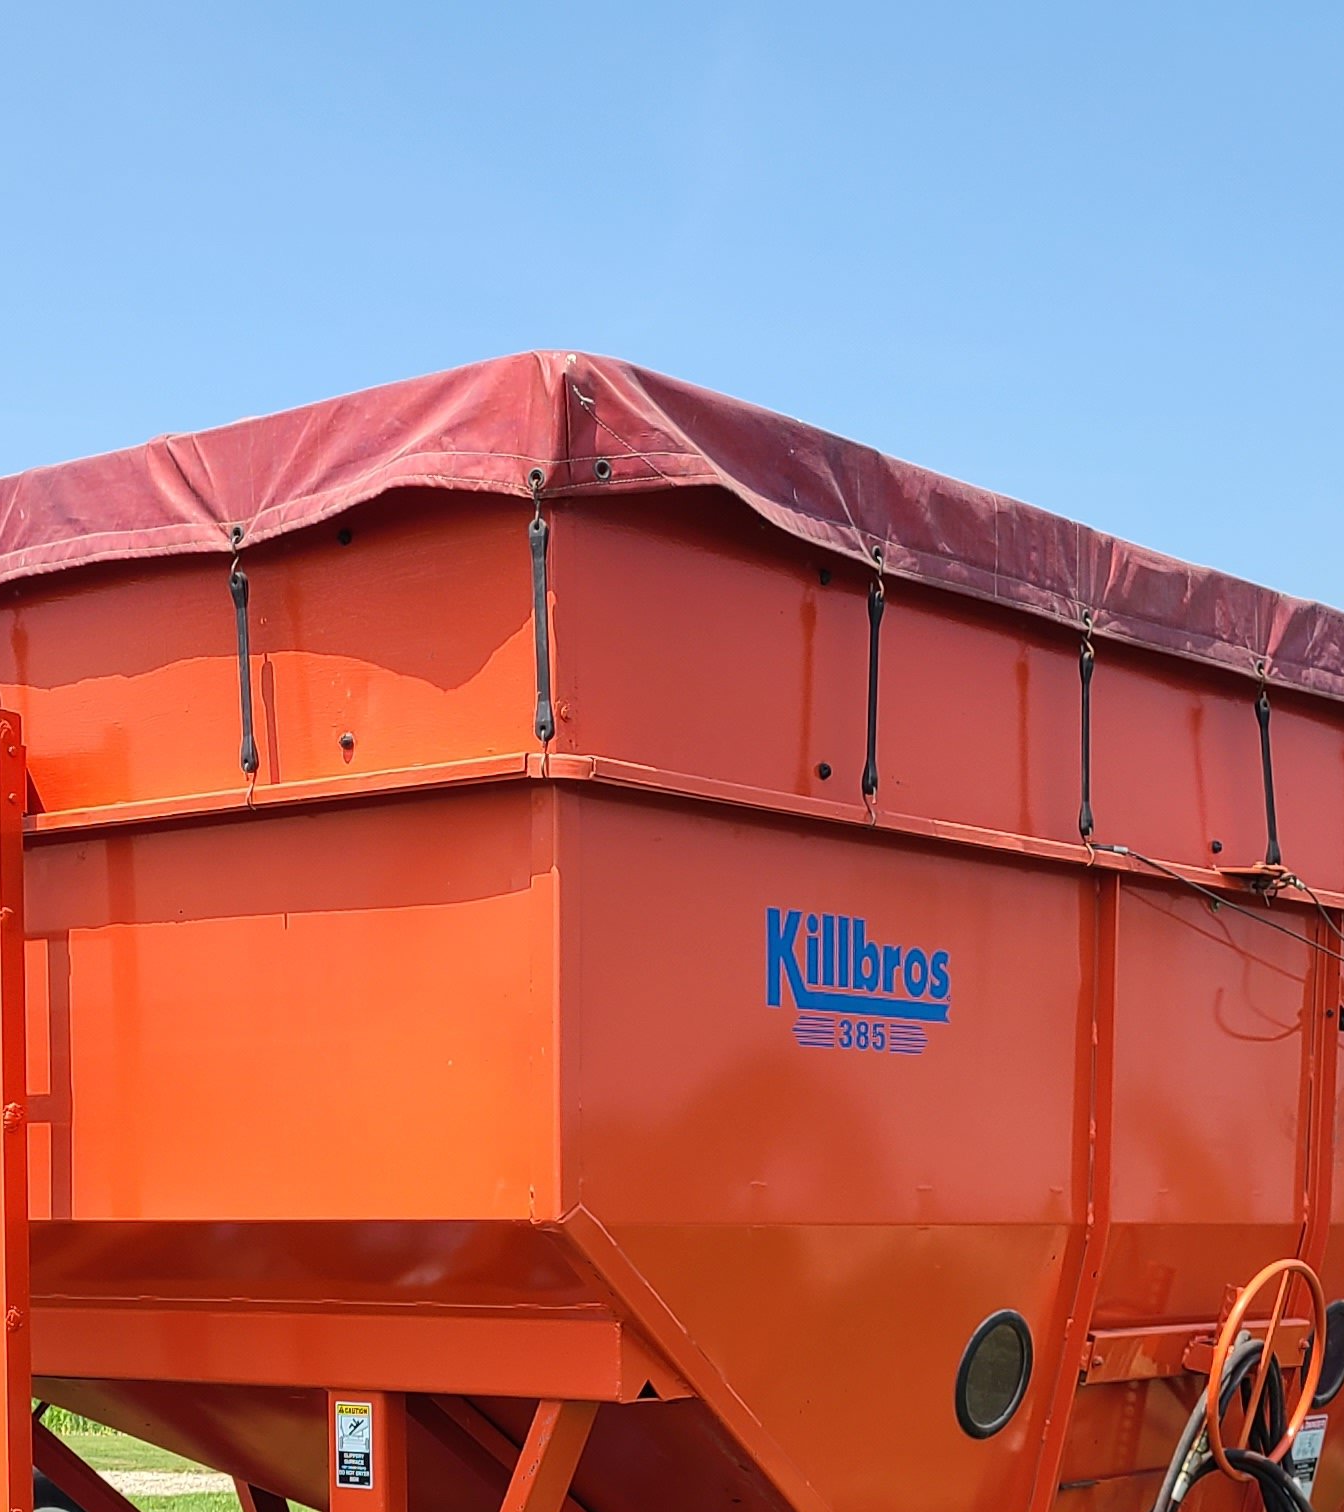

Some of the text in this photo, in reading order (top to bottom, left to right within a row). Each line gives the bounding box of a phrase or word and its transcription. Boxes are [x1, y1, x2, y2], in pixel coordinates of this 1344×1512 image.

[766, 907, 950, 1023] Killbros
[838, 1019, 886, 1050] 385
[344, 1407, 368, 1415] CAUTION
